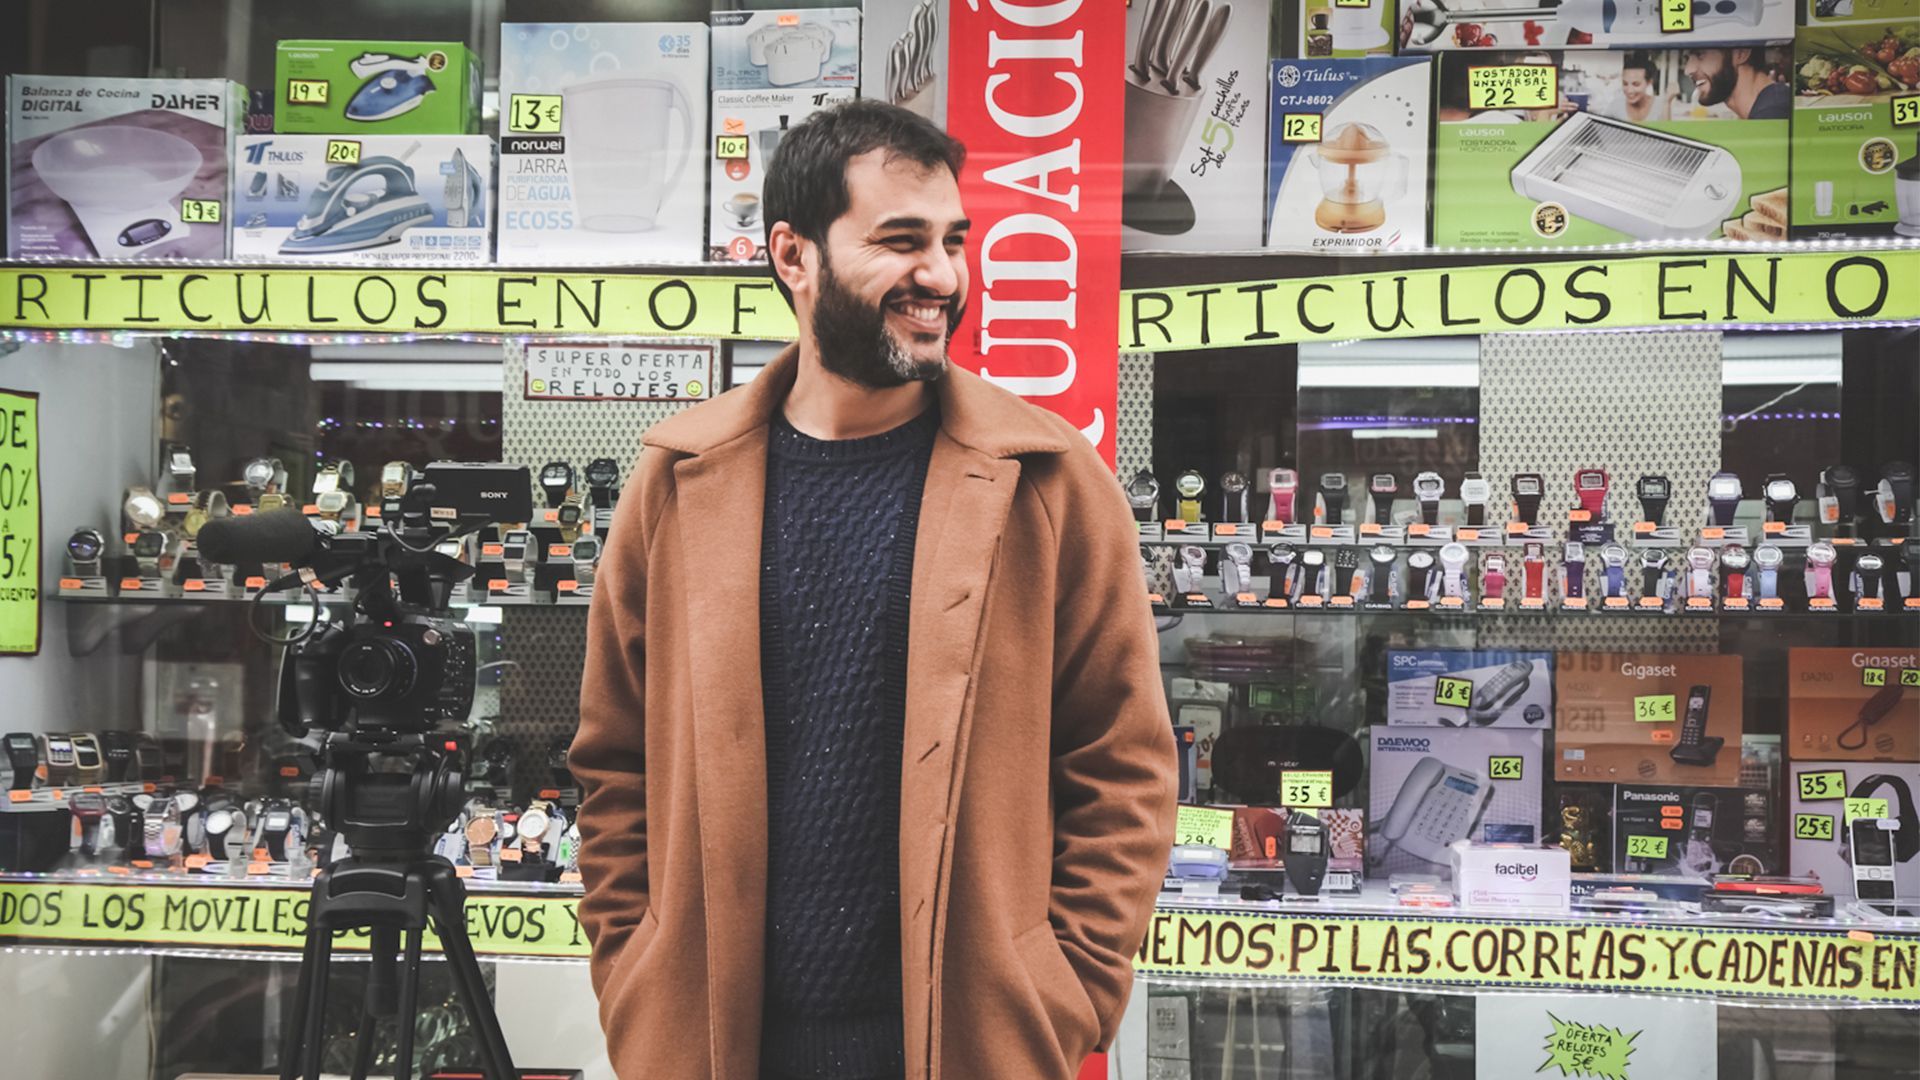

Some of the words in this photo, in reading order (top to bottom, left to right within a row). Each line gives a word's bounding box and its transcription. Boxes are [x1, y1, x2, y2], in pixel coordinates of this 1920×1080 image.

[1303, 66, 1346, 83] Tulus
[1474, 68, 1547, 78] TOSTADORA
[1474, 77, 1548, 88] UNIVARSAL
[21, 86, 72, 97] Balanza
[76, 87, 92, 98] de
[96, 88, 140, 99] Cocina
[292, 84, 309, 101] 19
[718, 95, 744, 104] Classic
[746, 94, 770, 104] Coffee
[771, 94, 794, 103] Maker
[1211, 70, 1239, 117] cuchillos
[1484, 87, 1516, 107] 22
[1535, 86, 1547, 101] €
[21, 99, 83, 112] DIGITAL
[151, 94, 220, 111] DAHER
[1896, 100, 1919, 122] 39
[1287, 119, 1305, 136] 12
[1310, 121, 1318, 135] €
[511, 141, 562, 151] norwei
[721, 142, 736, 154] 10
[516, 158, 568, 174] JARRA
[1190, 146, 1214, 177] Set
[505, 211, 574, 230] ECOSS
[980, 0, 1106, 440] UIDACI
[736, 239, 746, 256] 6
[1312, 236, 1382, 247] EXPRIMIDOR
[14, 274, 448, 328] RTICULOS
[497, 276, 606, 330] EN
[1118, 265, 1612, 350] RTICULOS
[1657, 257, 1783, 321] EN
[1825, 256, 1890, 321] O
[538, 350, 611, 366] SUPER
[621, 353, 703, 370] OFERTA
[551, 367, 571, 377] EN
[583, 368, 621, 378] TODO
[638, 370, 672, 382] LOS
[549, 380, 678, 398] RELOJES
[1393, 656, 1417, 667] SPC
[1621, 662, 1677, 680] Gigaset
[1438, 681, 1454, 700] 18
[1458, 686, 1469, 700] €
[1639, 701, 1656, 718] 36
[1661, 701, 1672, 715] €
[1378, 738, 1430, 747] DAEWOO
[1803, 776, 1828, 794] 35
[1289, 785, 1310, 803] 35
[1318, 787, 1327, 801] €
[1623, 791, 1680, 801] Panasonic
[1631, 838, 1650, 854] 32
[1655, 841, 1664, 854] €
[1495, 863, 1538, 875] facitel
[83, 893, 145, 931] LOS
[161, 894, 310, 937] MOVILES
[1872, 945, 1918, 990] EN
[1566, 1028, 1612, 1046] OFERTA
[1557, 1039, 1606, 1057] RELOJES
